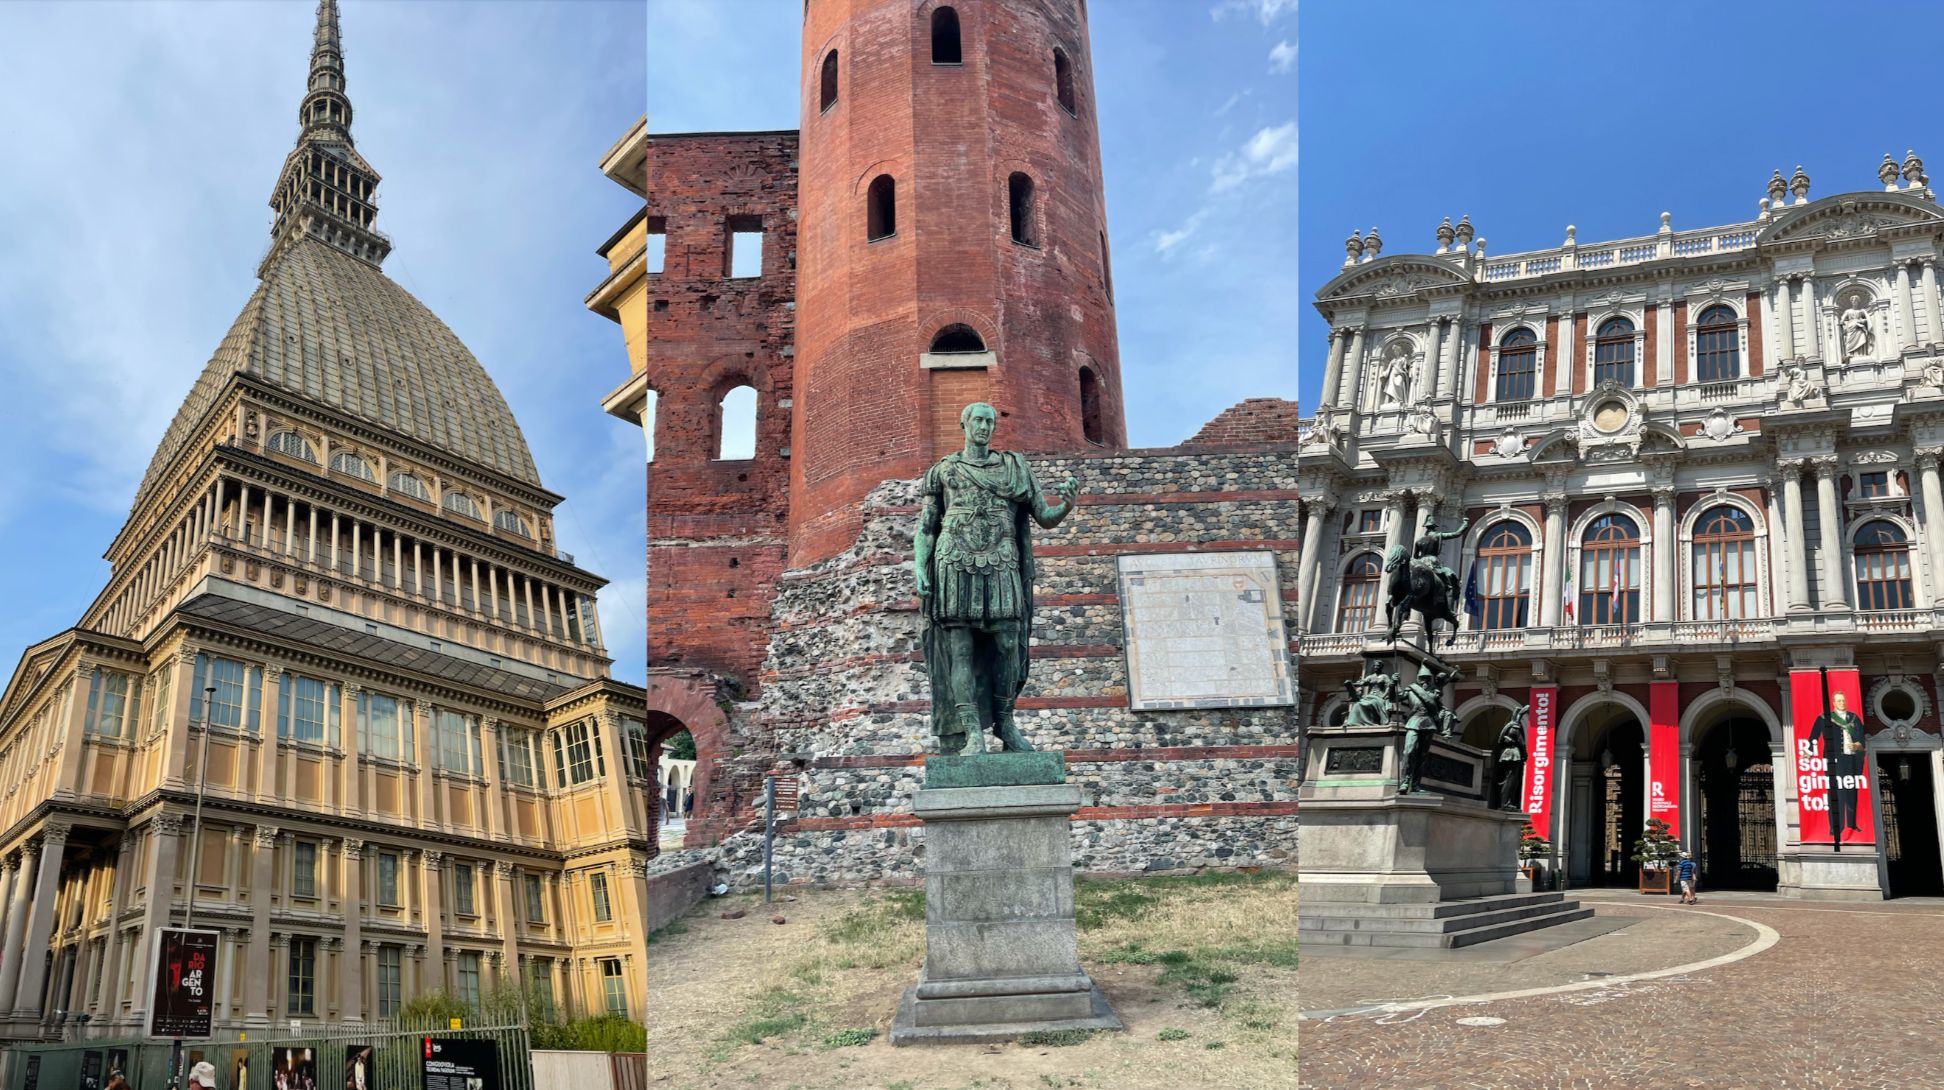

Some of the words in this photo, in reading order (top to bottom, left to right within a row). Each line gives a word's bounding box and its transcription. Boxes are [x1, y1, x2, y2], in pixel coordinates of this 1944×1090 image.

[1798, 738, 1818, 756] Ri
[1528, 693, 1549, 814] Risorgimento!
[1652, 781, 1664, 797] R
[1801, 793, 1830, 811] to!
[193, 952, 206, 961] DA
[188, 960, 205, 969] RIO
[189, 969, 203, 978] AR
[181, 977, 201, 987] GEN
[190, 986, 203, 996] TO
